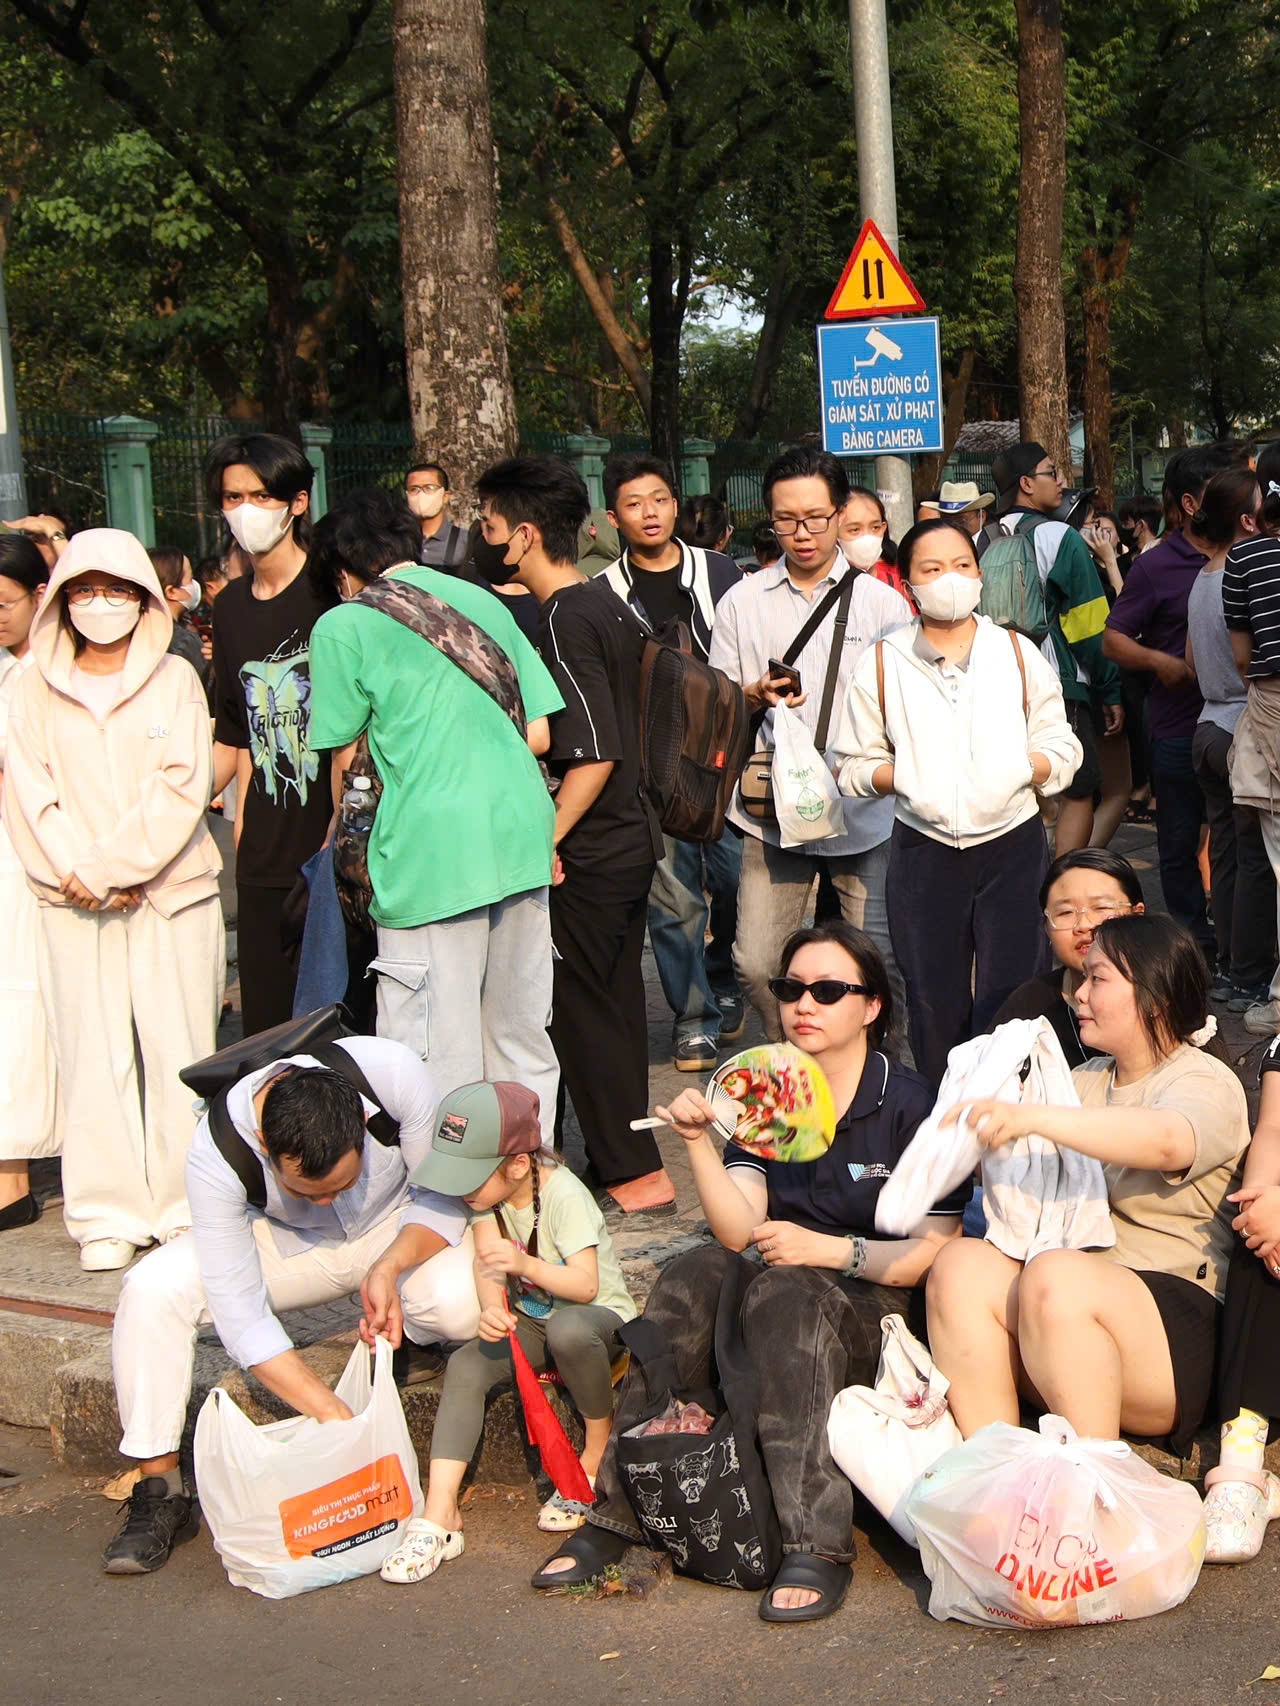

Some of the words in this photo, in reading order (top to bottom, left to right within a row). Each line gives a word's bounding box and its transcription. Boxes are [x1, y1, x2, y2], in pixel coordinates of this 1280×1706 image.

[831, 372, 869, 398] TUYẾN
[871, 372, 912, 395] ĐƯỜNG
[914, 370, 930, 393] CÓ
[828, 401, 857, 424] GIÁM
[886, 397, 902, 420] XỬ
[905, 400, 935, 424] PHẠT
[842, 424, 874, 449] BẰNG
[876, 428, 924, 448] CAMERA
[331, 1540, 352, 1553] NGON
[355, 1528, 374, 1545] CHẤT
[994, 1552, 1118, 1602] ONLINE
